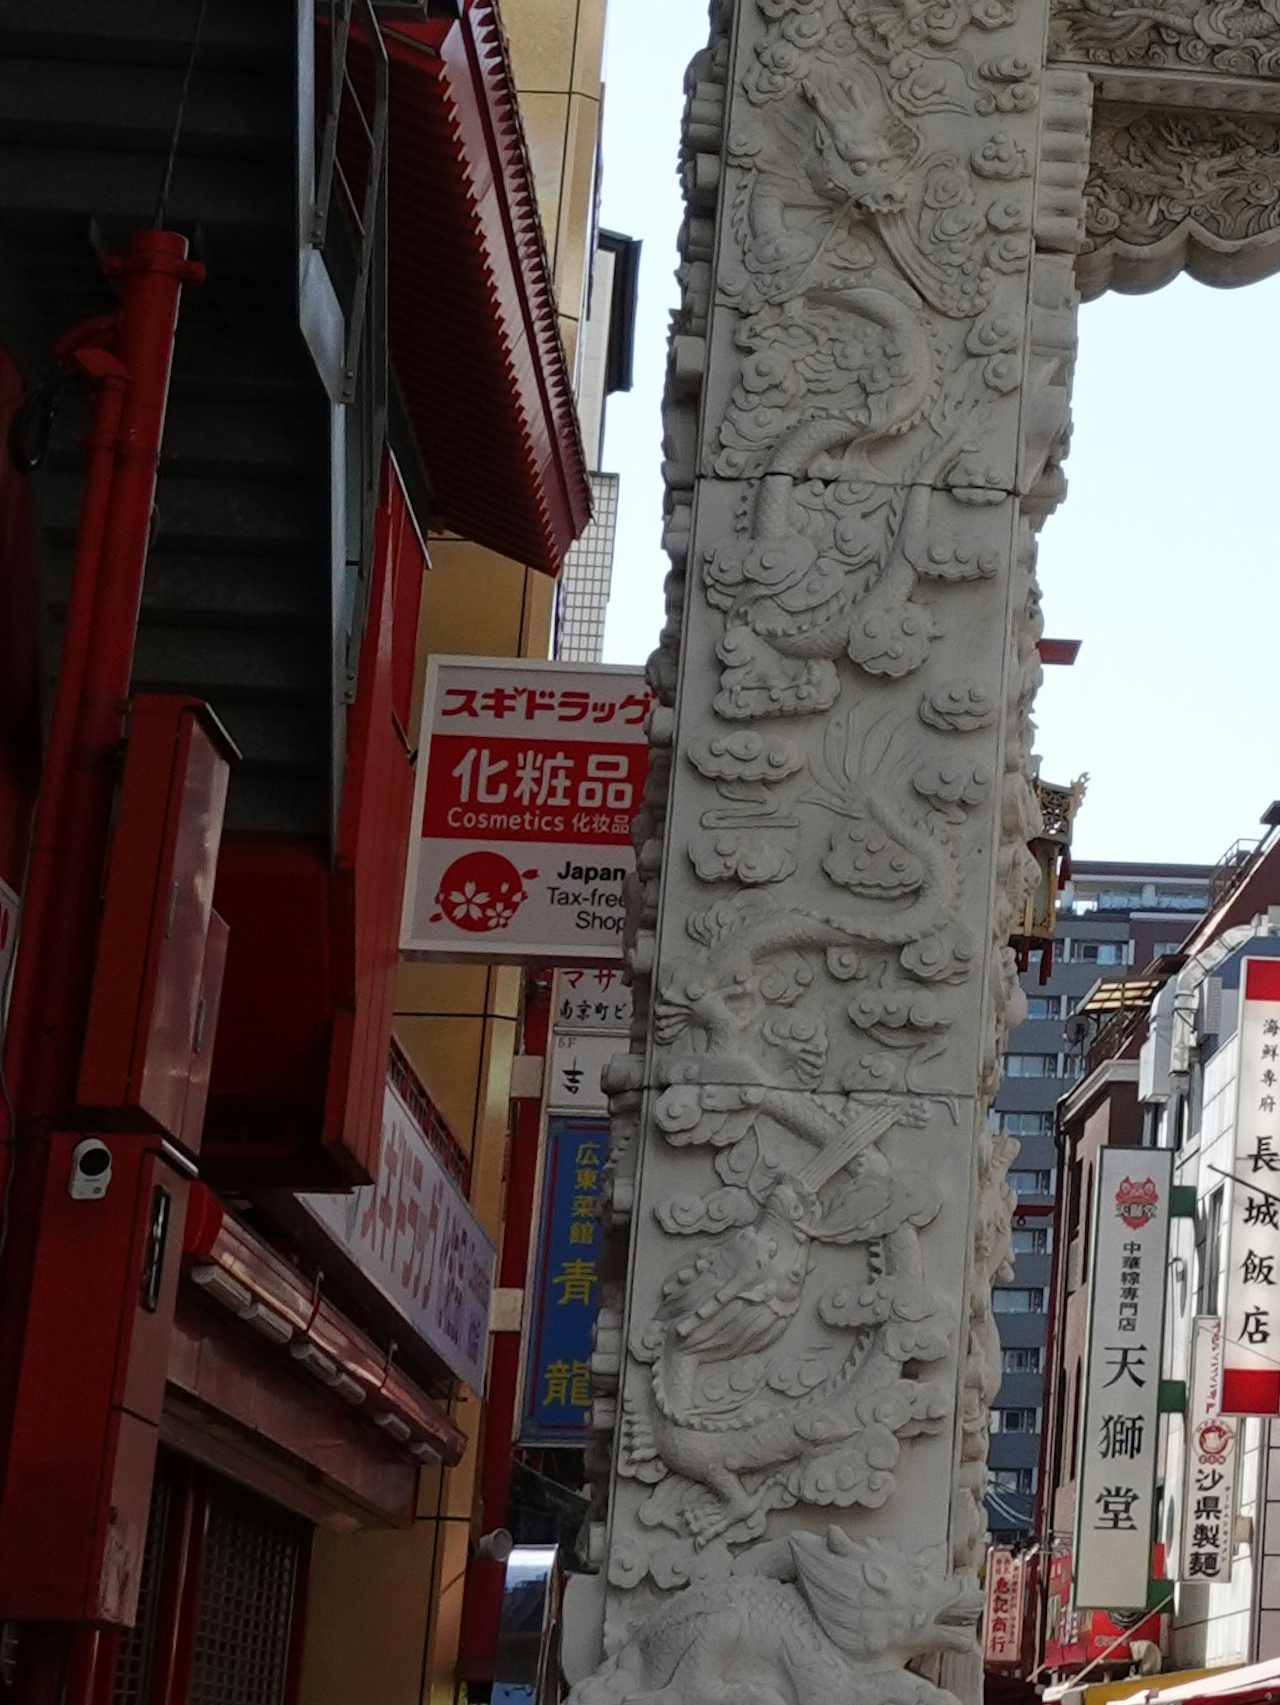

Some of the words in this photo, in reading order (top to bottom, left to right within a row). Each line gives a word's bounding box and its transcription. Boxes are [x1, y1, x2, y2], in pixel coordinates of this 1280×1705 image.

[441, 686, 659, 725] スギドラッグ
[451, 746, 634, 810] 化粧品
[446, 807, 565, 833] Cosmetics
[556, 861, 627, 883] Japan
[560, 998, 634, 1021] 南京町ビ
[1238, 1135, 1280, 1346] 長城飯店
[1093, 1343, 1148, 1531] 天獅堂
